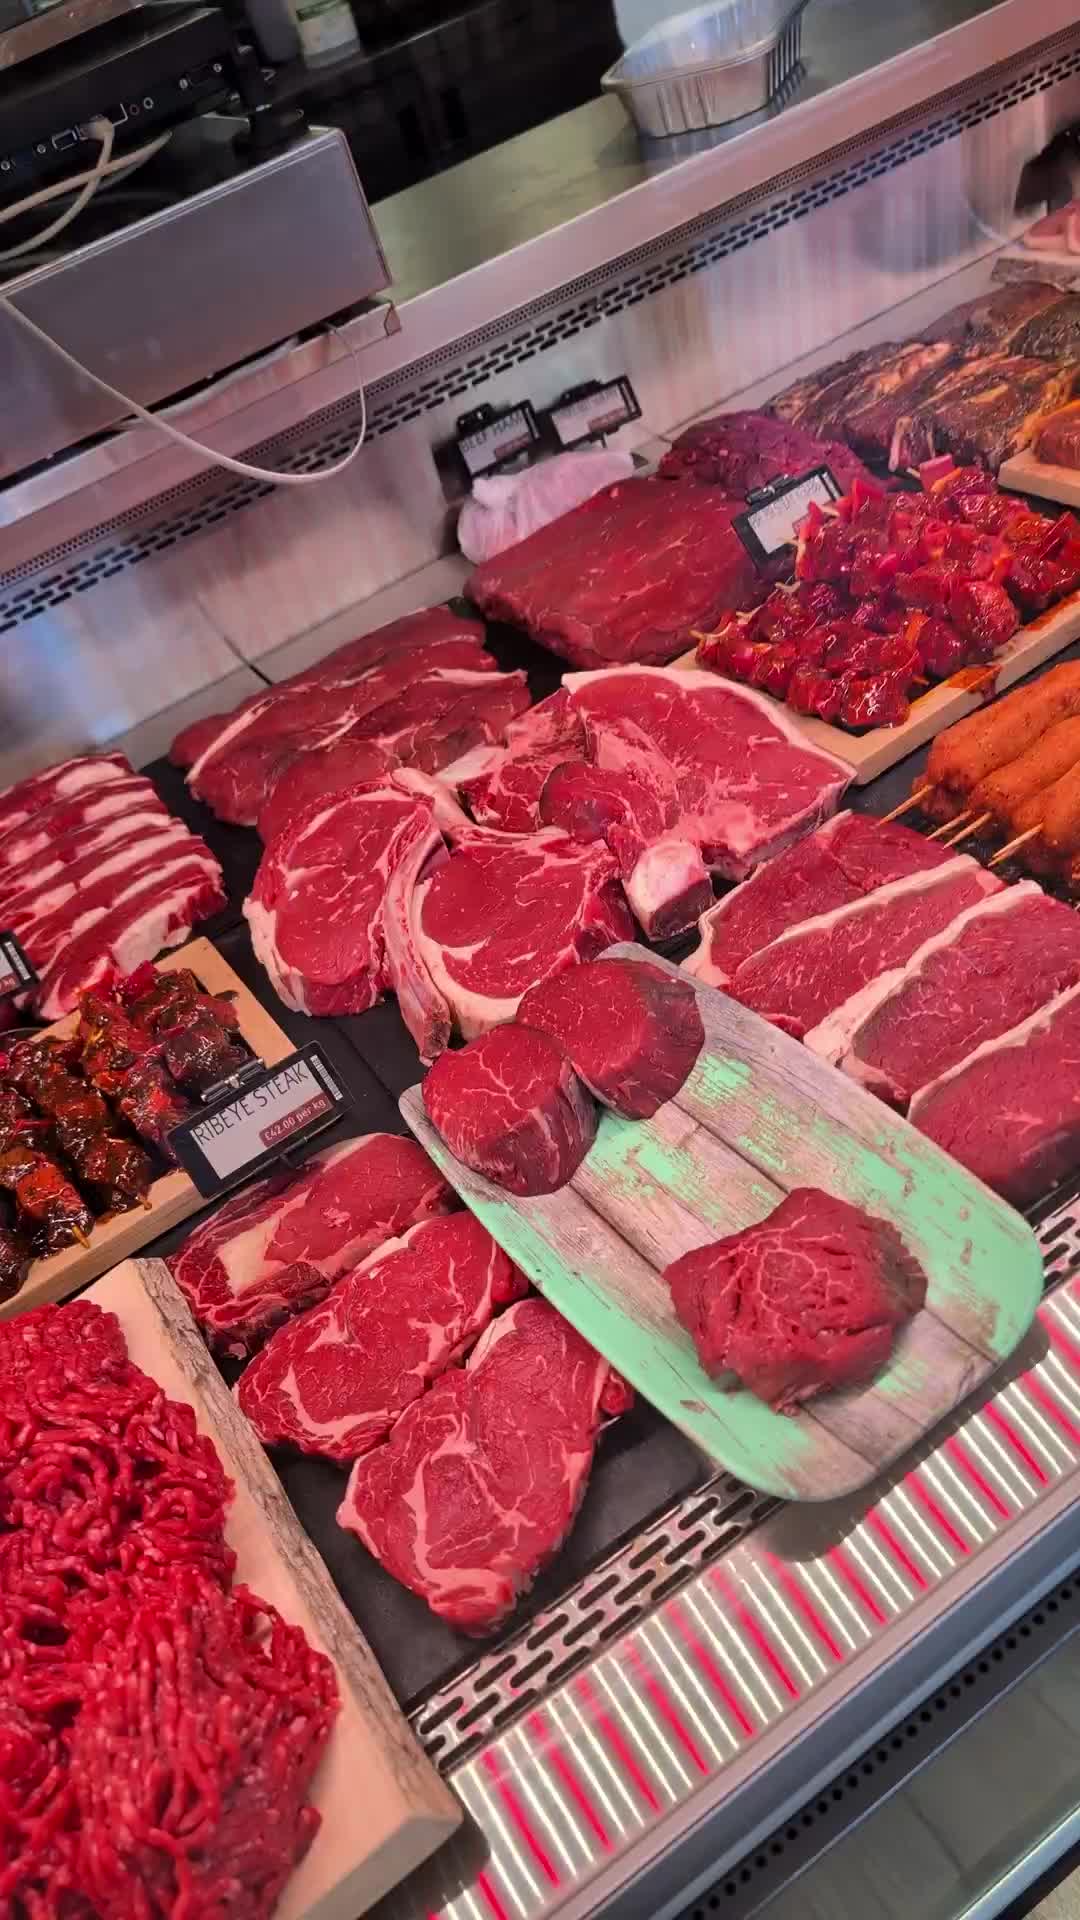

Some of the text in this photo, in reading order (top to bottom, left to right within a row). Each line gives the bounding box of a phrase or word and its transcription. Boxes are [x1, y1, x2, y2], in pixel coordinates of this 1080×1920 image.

[192, 1063, 309, 1145] RIBEYE STEAK
[264, 1098, 327, 1141] £42.00 per kg
